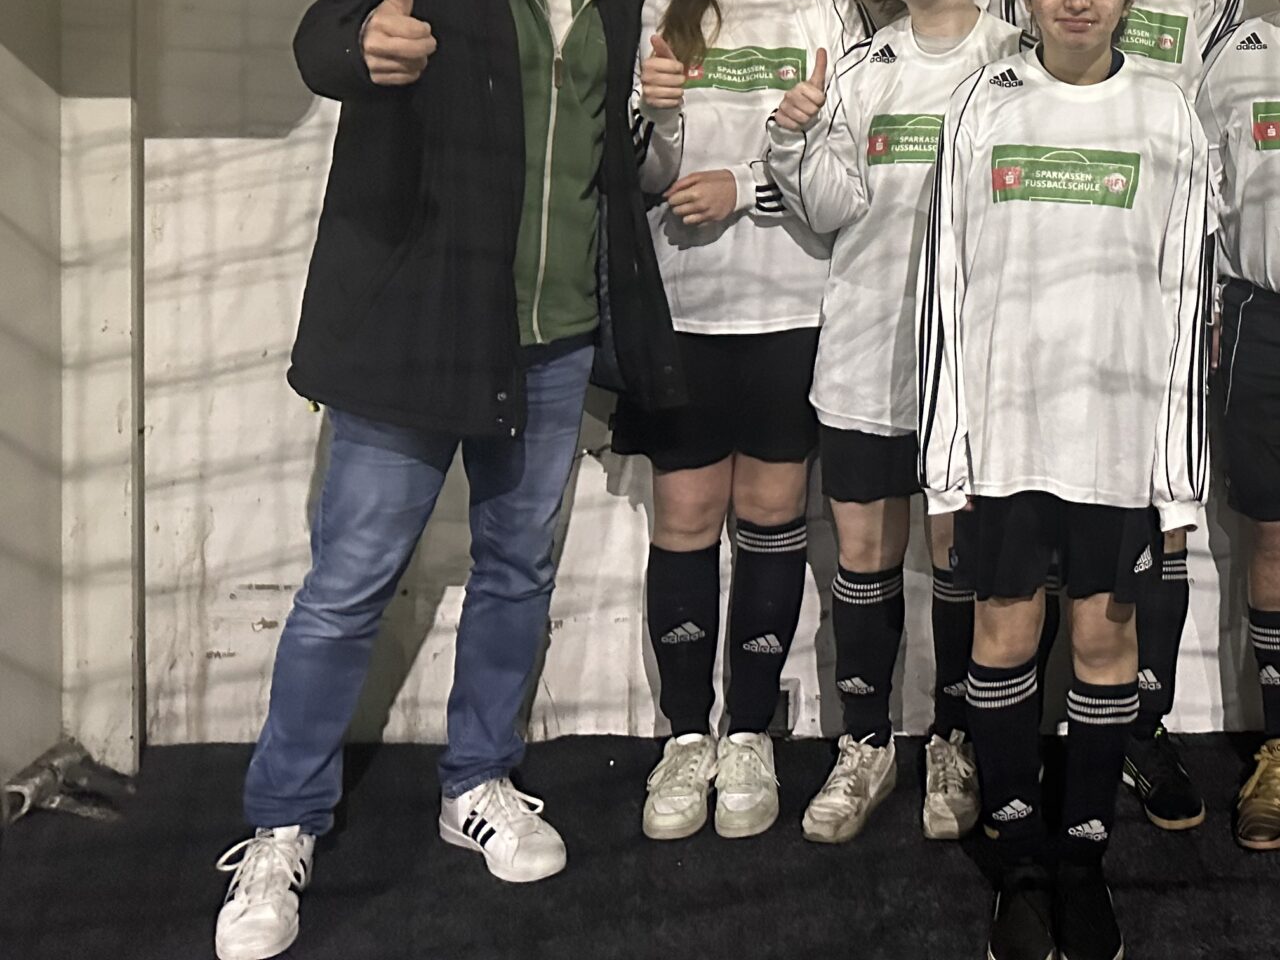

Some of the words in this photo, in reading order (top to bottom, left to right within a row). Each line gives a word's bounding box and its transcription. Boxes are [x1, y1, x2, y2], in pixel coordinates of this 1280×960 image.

[1236, 42, 1268, 50] adidas
[717, 65, 765, 75] SPARKASSEN
[708, 72, 773, 82] FUSSBALLSCHULE
[989, 77, 1024, 88] adidas
[899, 135, 939, 143] SPARKASS
[890, 144, 937, 152] FUSSBALLSC
[1035, 170, 1092, 181] SPARKASSEN
[1025, 179, 1100, 191] FUSSBALLSCHULE
[661, 630, 705, 644] adidas
[743, 642, 783, 654] adidas
[992, 805, 1033, 821] adidas
